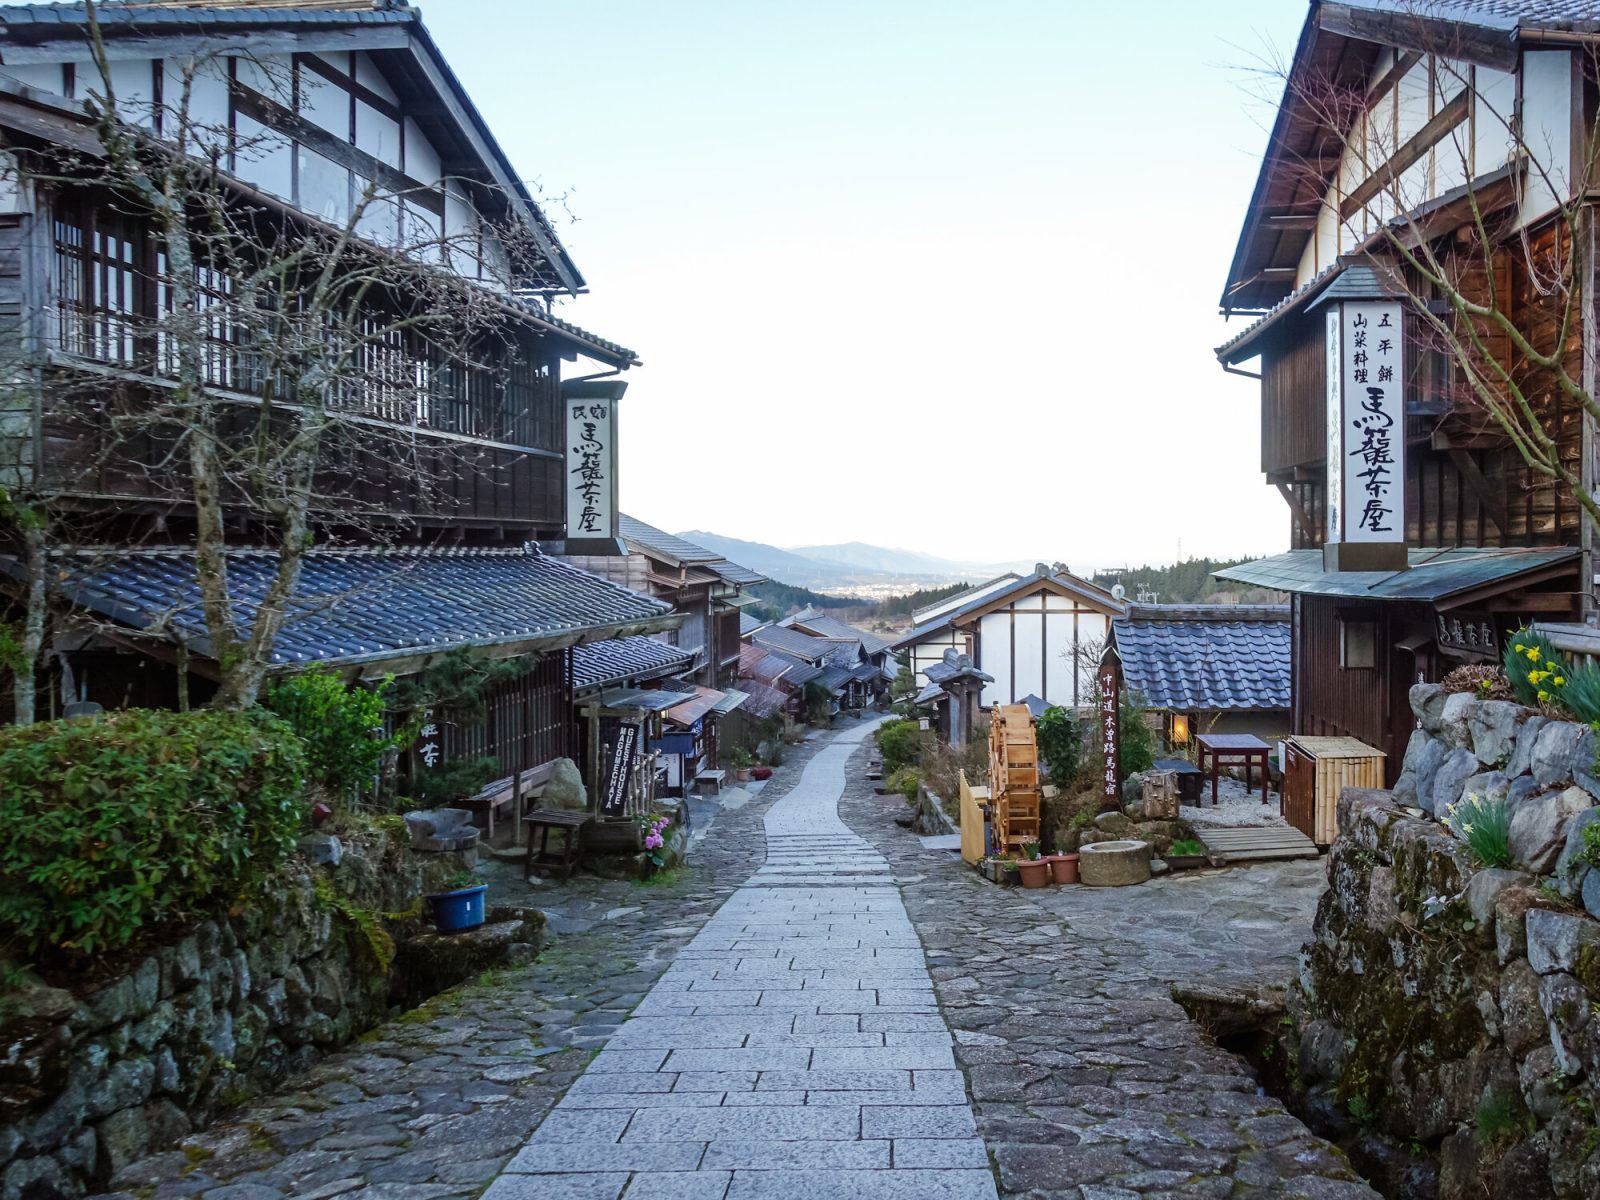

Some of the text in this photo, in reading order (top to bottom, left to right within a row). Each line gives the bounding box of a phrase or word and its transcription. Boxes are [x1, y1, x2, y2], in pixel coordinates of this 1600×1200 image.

[1353, 313, 1368, 384] 山菜料理
[1378, 313, 1393, 383] 五平餅
